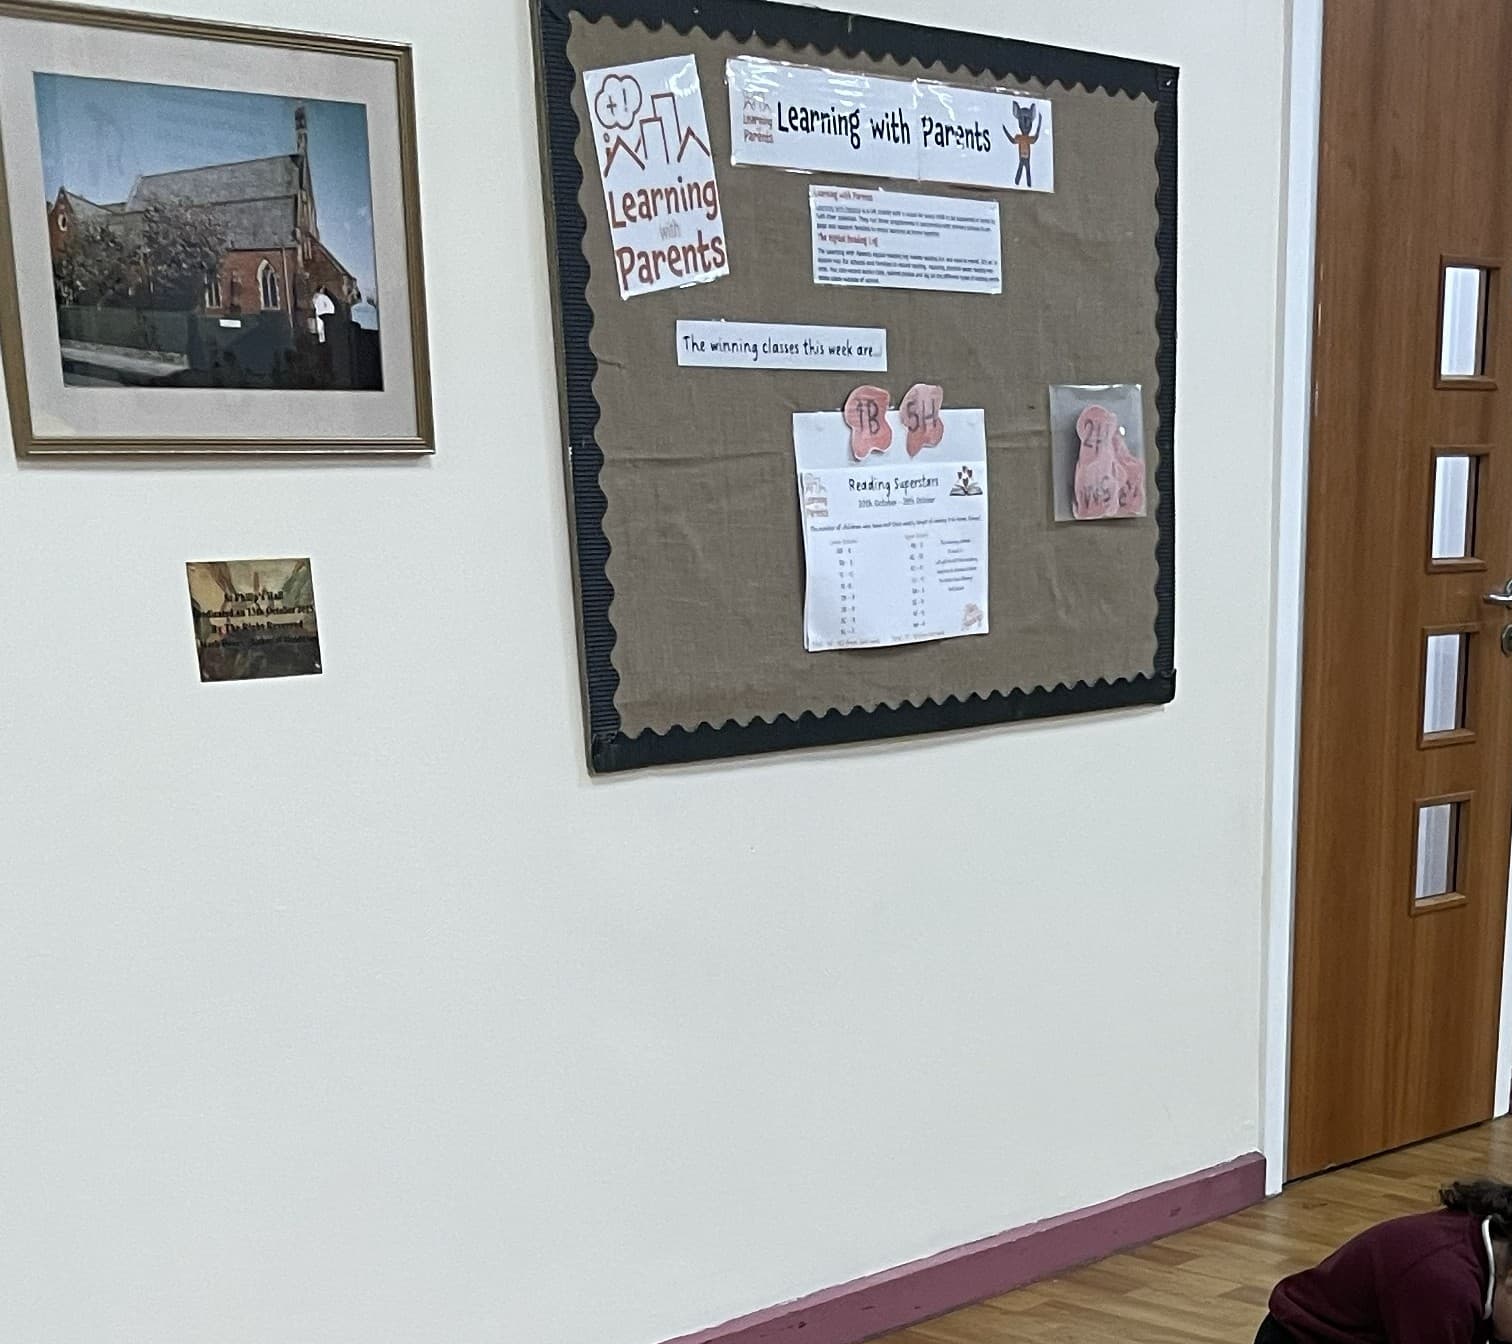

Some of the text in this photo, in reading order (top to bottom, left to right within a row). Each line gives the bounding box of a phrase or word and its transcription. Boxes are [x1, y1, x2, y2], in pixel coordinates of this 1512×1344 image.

[777, 101, 992, 153] Learning with Parents
[608, 175, 719, 229] Learning
[615, 229, 726, 291] Parents
[683, 334, 706, 354] The
[710, 336, 758, 362] winning
[762, 336, 800, 355] classes
[804, 336, 824, 355] this
[828, 339, 852, 357] week
[849, 474, 940, 498] Reading Superstars
